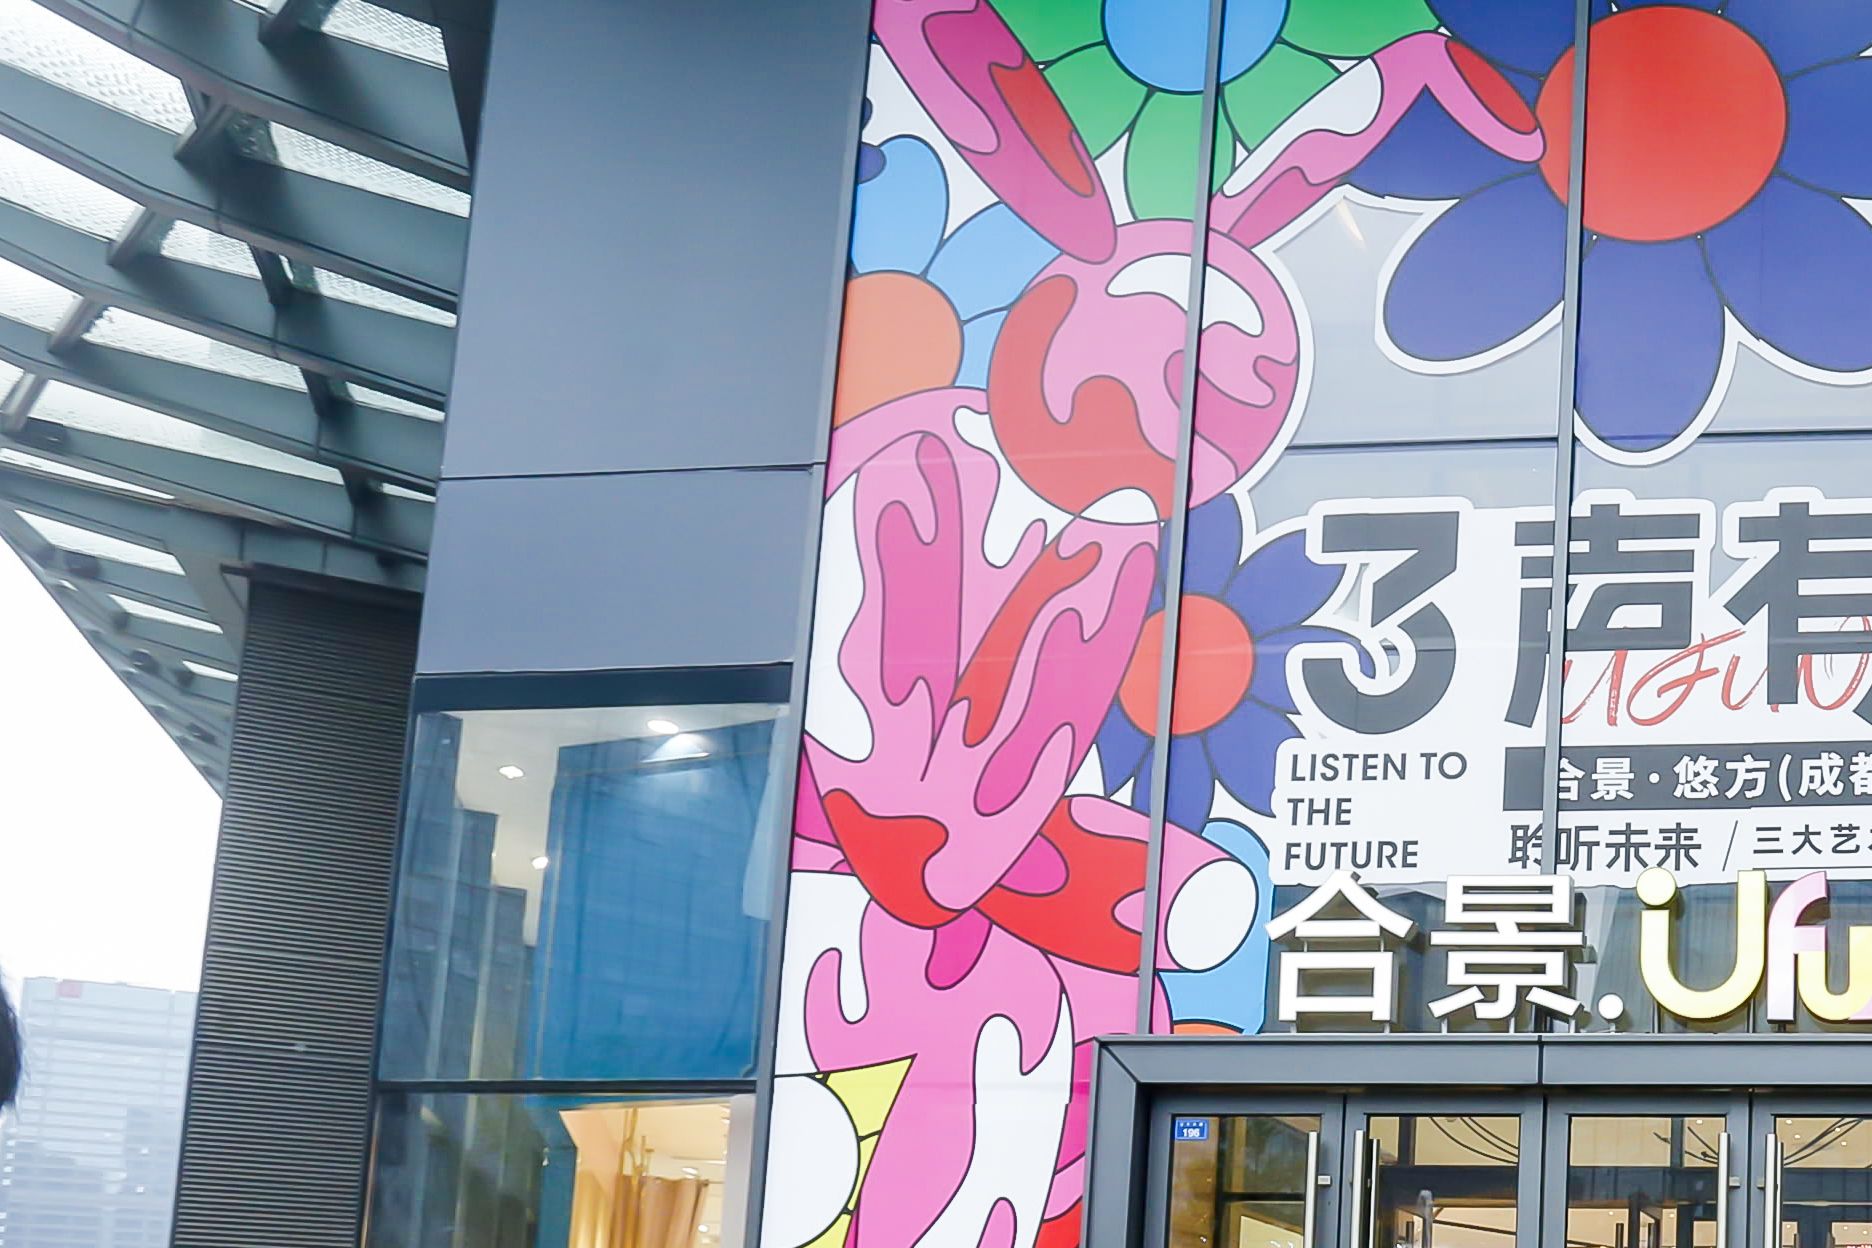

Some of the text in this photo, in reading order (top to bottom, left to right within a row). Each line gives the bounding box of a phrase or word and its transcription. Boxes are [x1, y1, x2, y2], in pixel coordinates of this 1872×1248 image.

[1290, 751, 1468, 782] LISTEN TO
[1287, 797, 1352, 826] THE
[1284, 840, 1419, 871] FUTURE
[1182, 1127, 1201, 1138] 196
